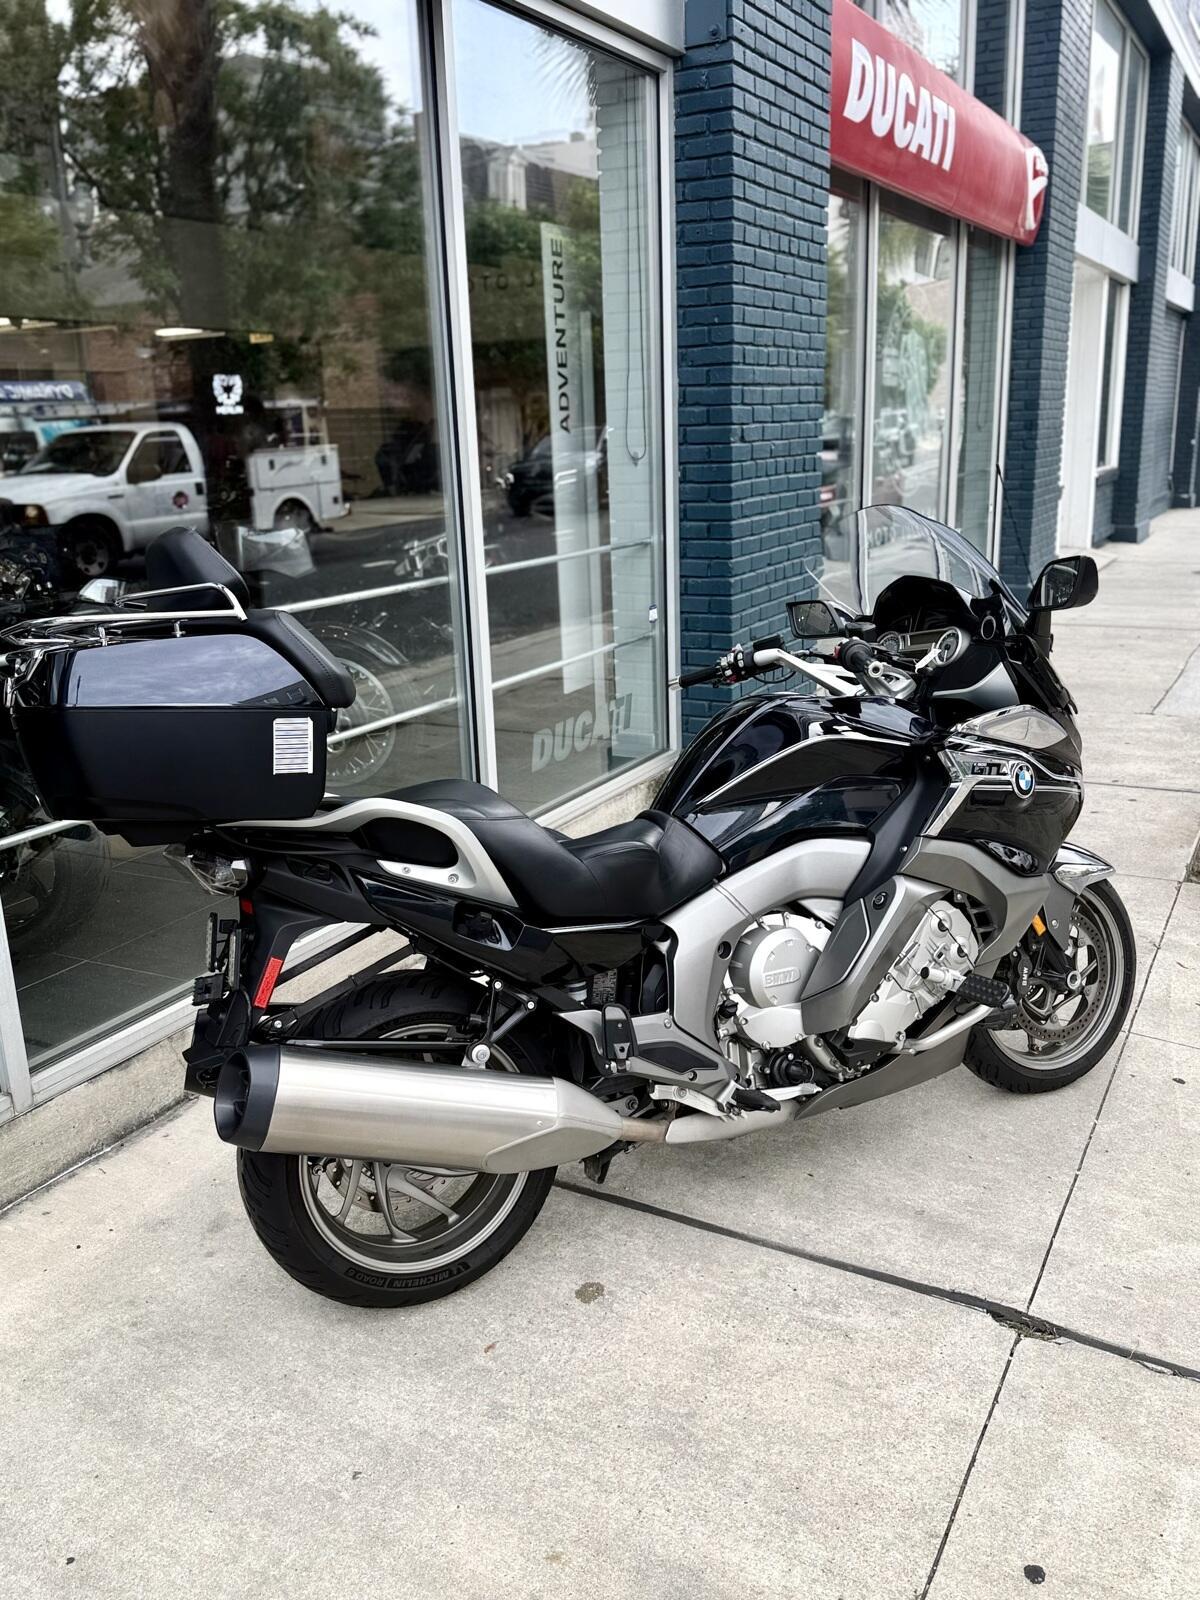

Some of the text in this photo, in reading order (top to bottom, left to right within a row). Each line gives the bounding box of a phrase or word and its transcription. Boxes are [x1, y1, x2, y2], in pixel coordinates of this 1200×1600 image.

[843, 38, 956, 172] DUCATI
[550, 238, 571, 434] ADVENTURE
[532, 693, 633, 773] DUCATI
[1021, 966, 1029, 987] BMW
[355, 1272, 384, 1287] ROAD
[393, 1269, 449, 1288] MICHELIN
